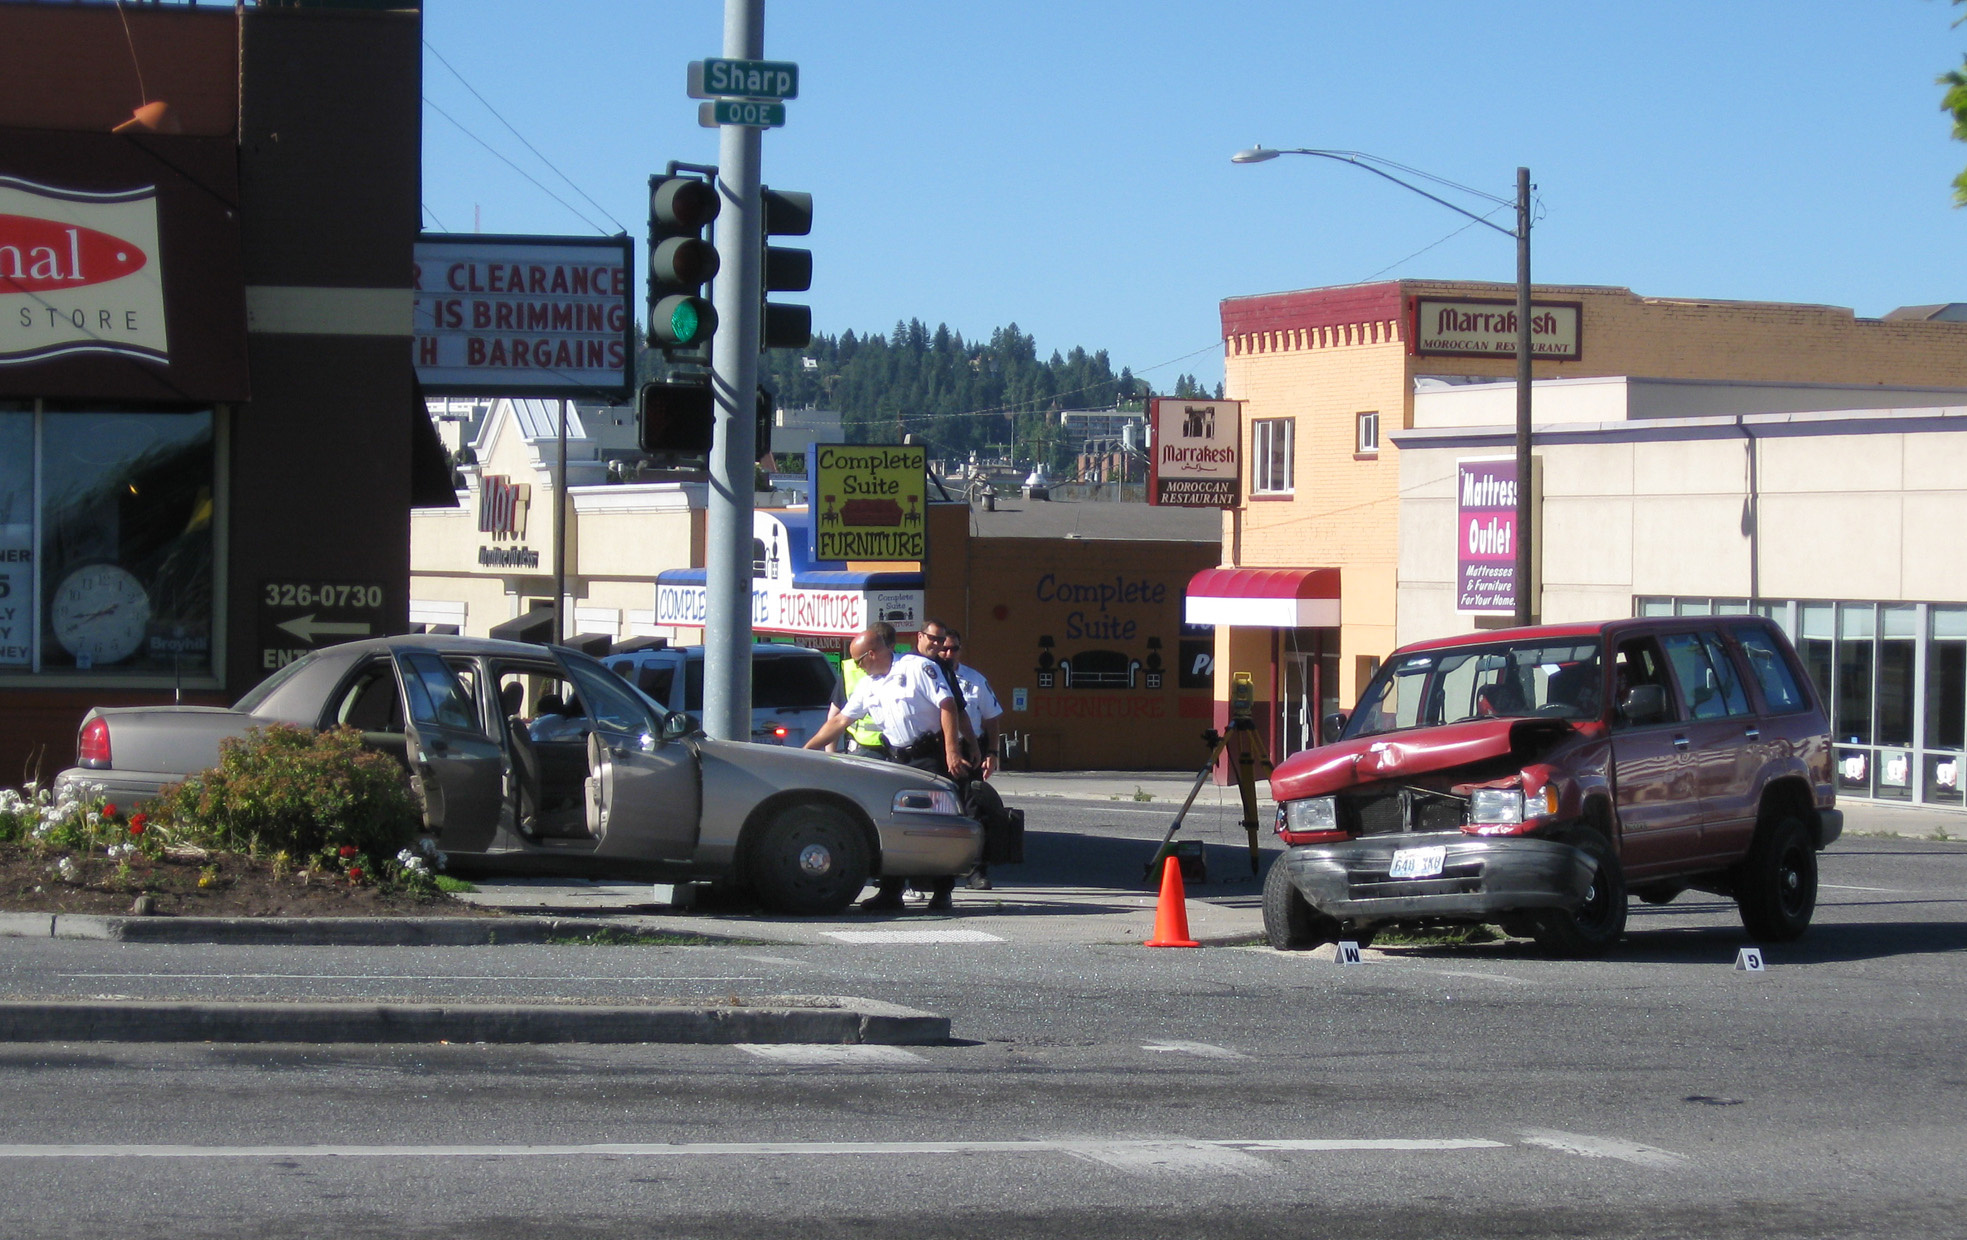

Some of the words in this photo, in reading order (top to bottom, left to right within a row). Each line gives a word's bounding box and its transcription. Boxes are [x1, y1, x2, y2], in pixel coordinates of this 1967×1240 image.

[711, 62, 791, 96] Sharp
[447, 263, 624, 296] CLEARANCE
[20, 307, 138, 331] STORE
[435, 300, 463, 329] IS
[473, 301, 625, 332] BRIMMING
[1437, 308, 1557, 336] Marraksh
[411, 335, 438, 366] H
[467, 337, 625, 369] BARGAINS
[1423, 339, 1489, 350] MOROCCAN
[1495, 341, 1570, 353] RESURANT
[820, 449, 923, 475] Complete
[1162, 444, 1235, 464] Marrakesh
[843, 475, 900, 495] Suite
[1166, 481, 1230, 493] MOROCCAN
[1161, 493, 1235, 504] RESTAURANT
[820, 531, 923, 557] FURNITURE
[1468, 516, 1511, 554] Outlet
[1466, 565, 1513, 577] Mattresses
[265, 584, 382, 607] 326-0730
[1037, 573, 1166, 612] Complete
[1467, 579, 1474, 591] &
[1475, 579, 1512, 591] Furniture
[660, 588, 707, 621] COMPLE
[779, 594, 860, 629] FURNITURE
[878, 593, 914, 603] Complete
[1461, 594, 1474, 606] For
[1475, 594, 1491, 606] Your
[1492, 594, 1516, 606] Home.
[1067, 612, 1137, 640] Suite
[795, 637, 841, 649] ENTRANCE
[263, 649, 314, 668] ENT
[1033, 694, 1166, 719] FURNITURE
[1747, 954, 1760, 969] G
